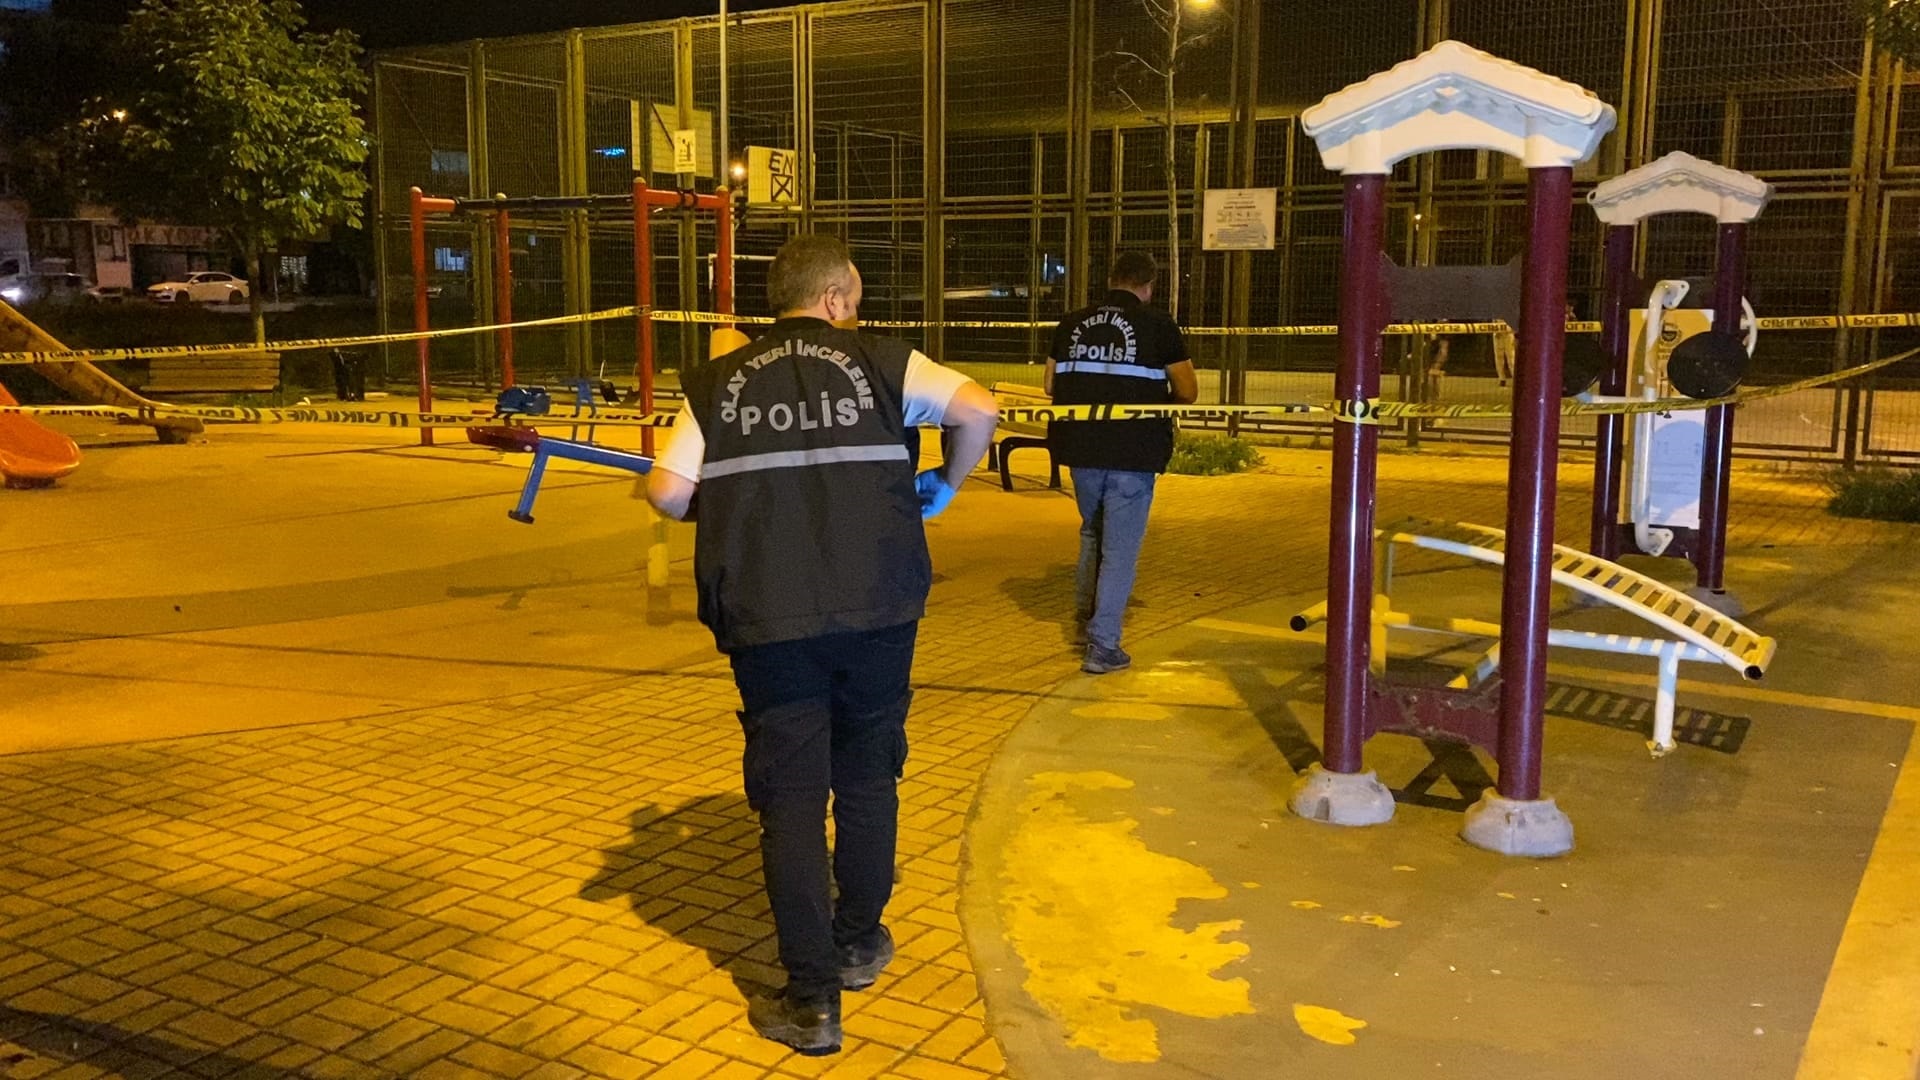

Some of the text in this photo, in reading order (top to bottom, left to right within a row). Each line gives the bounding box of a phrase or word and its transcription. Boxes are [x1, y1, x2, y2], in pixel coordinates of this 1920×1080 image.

[768, 151, 794, 174] EN
[1068, 327, 1082, 359] OLAY
[721, 369, 748, 424] OLAY
[740, 391, 859, 436] POLİS
